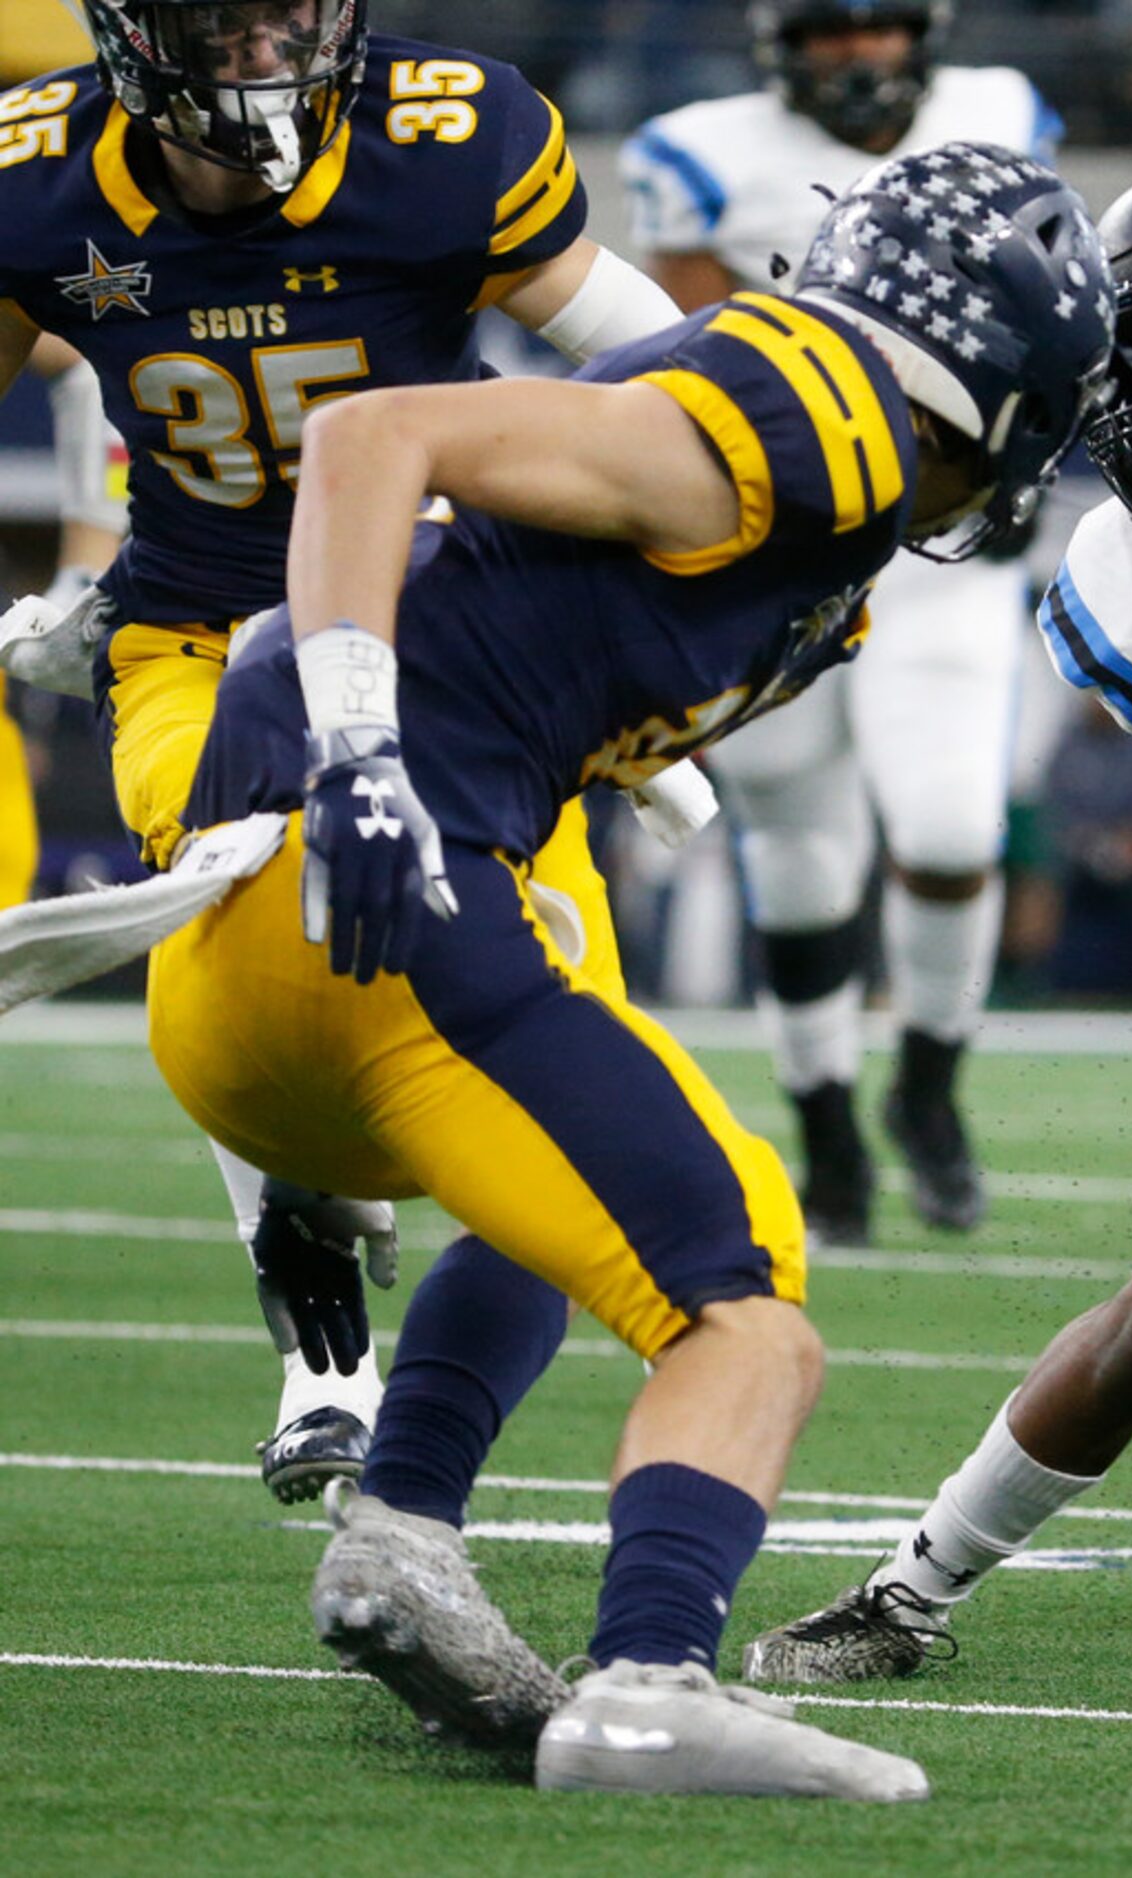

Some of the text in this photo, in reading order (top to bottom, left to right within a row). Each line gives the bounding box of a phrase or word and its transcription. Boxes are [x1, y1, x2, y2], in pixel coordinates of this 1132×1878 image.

[0, 81, 78, 169] 35
[386, 59, 485, 145] 35
[188, 303, 287, 340] SCOTS
[128, 336, 370, 509] 35
